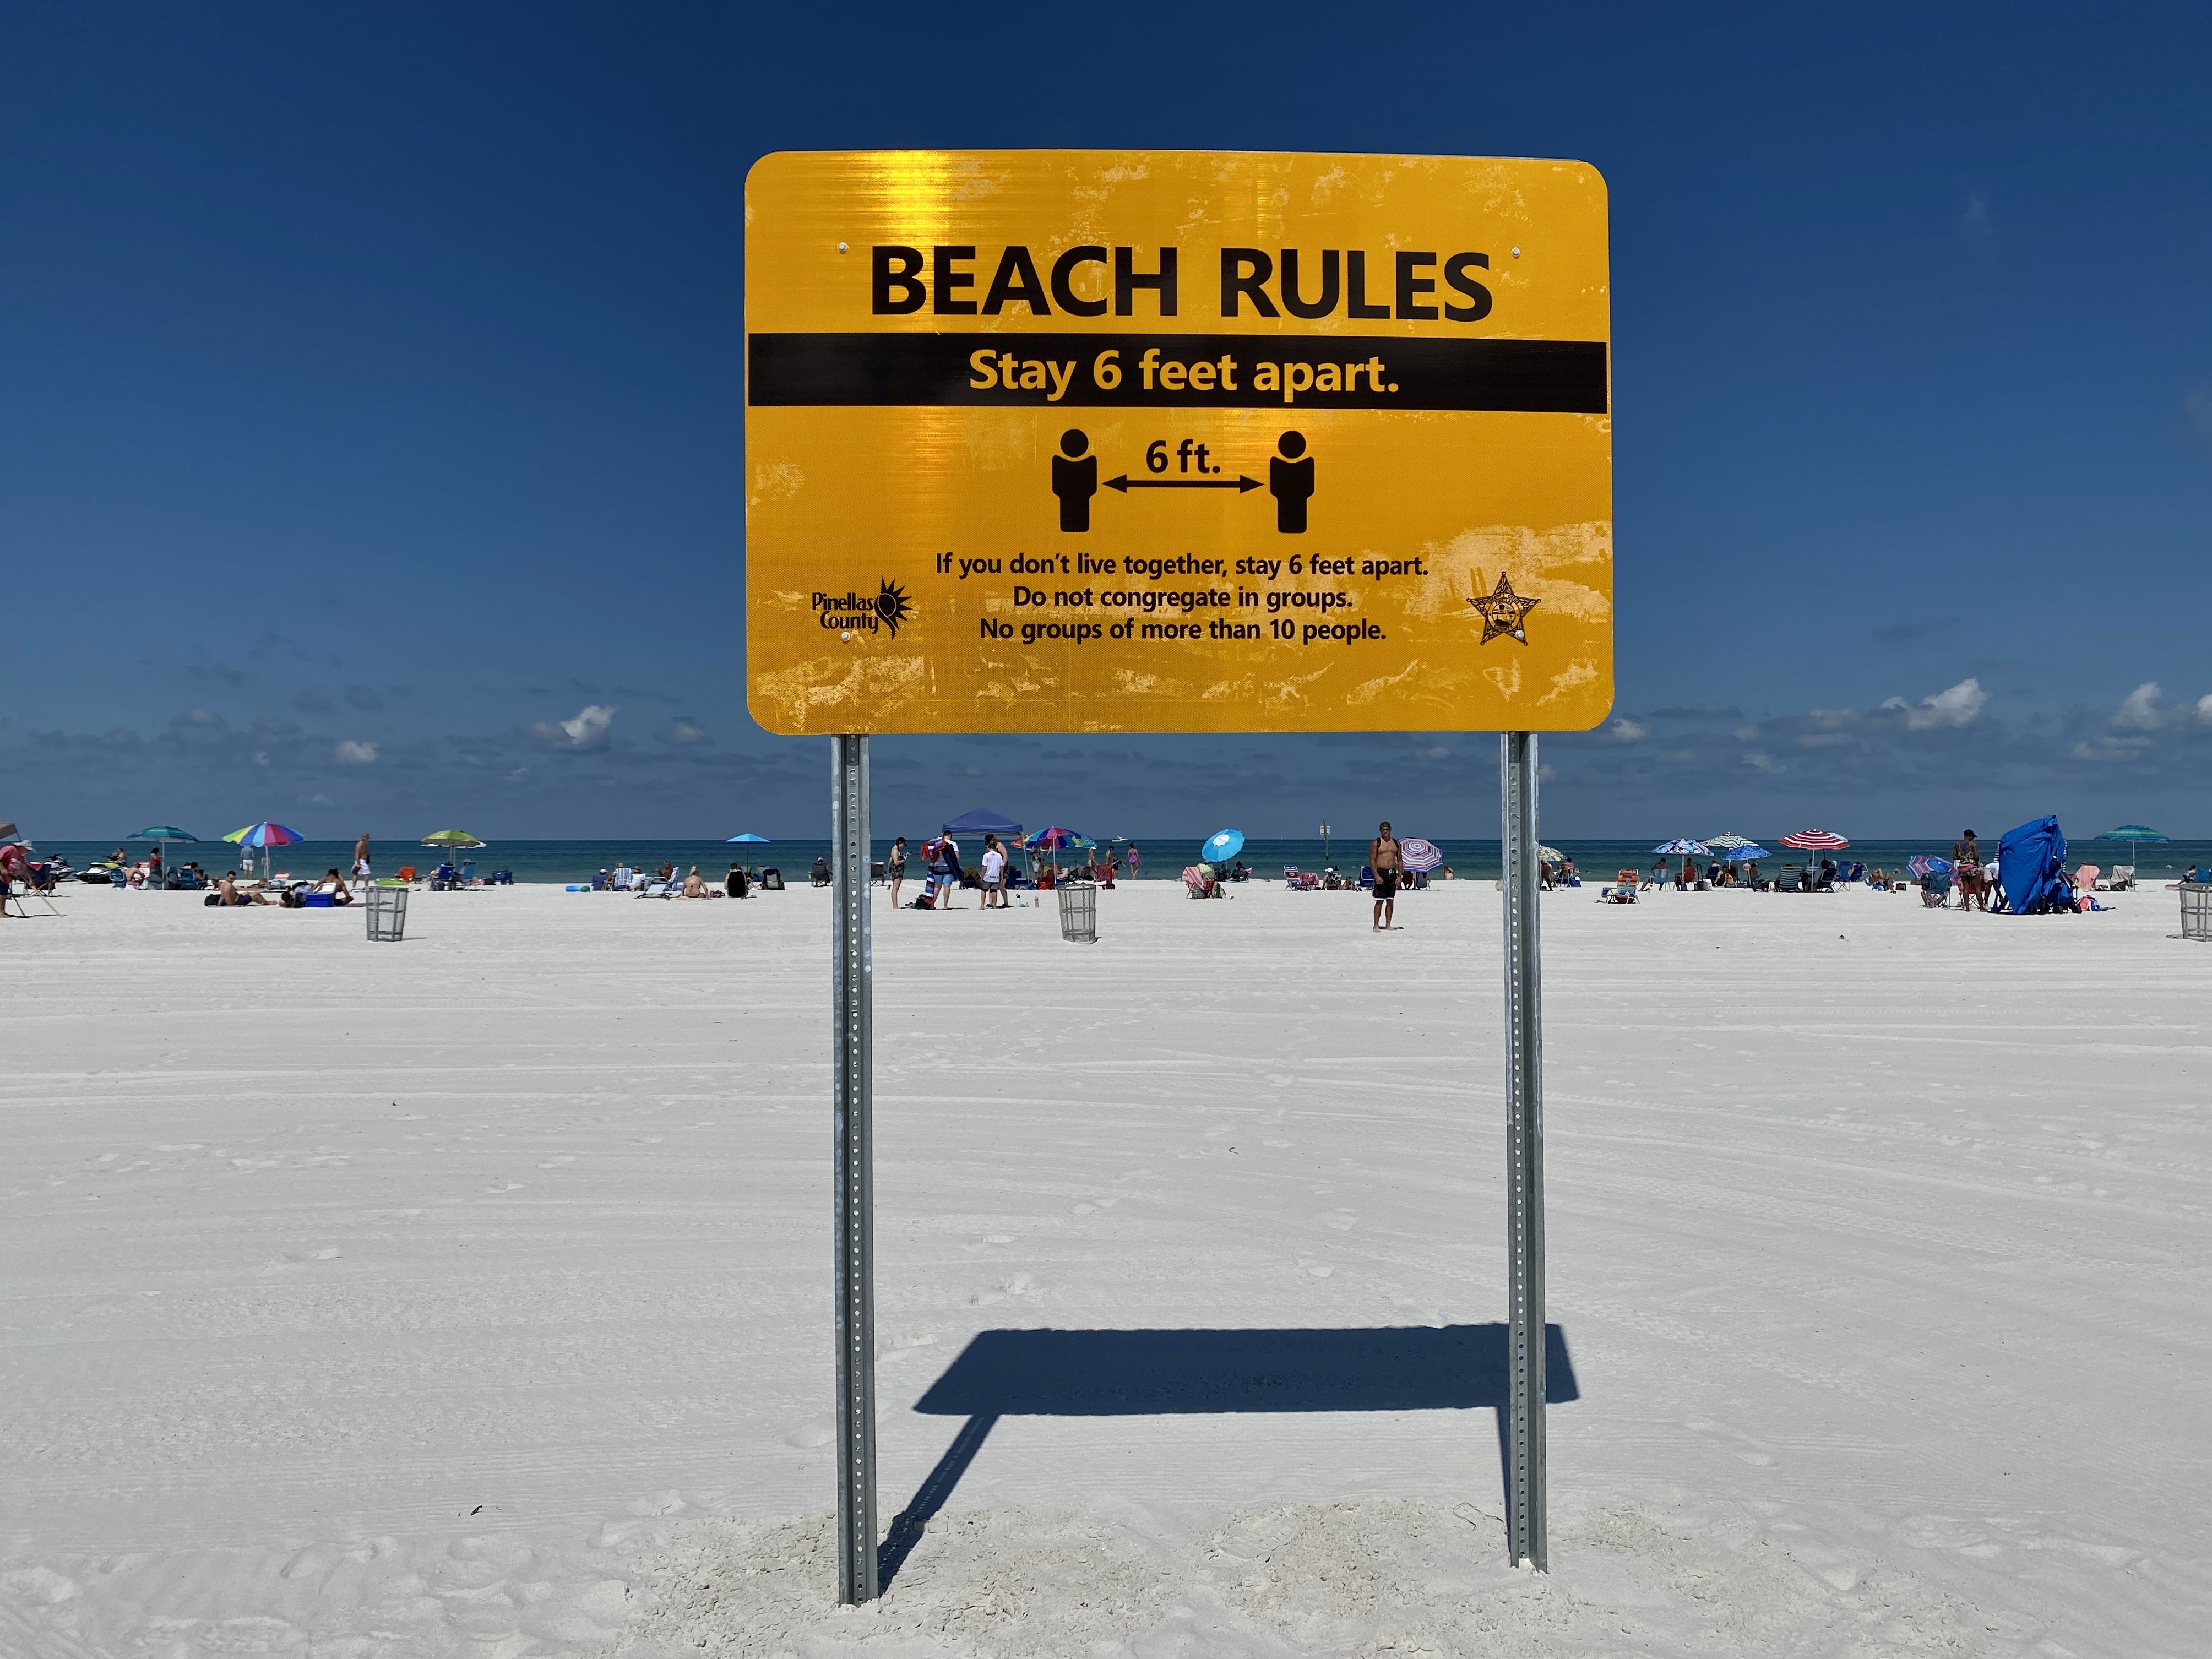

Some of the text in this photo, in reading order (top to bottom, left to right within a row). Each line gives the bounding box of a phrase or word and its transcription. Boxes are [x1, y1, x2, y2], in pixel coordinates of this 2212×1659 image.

[872, 245, 1492, 322] BEACH RULES
[970, 348, 1399, 404] Stay 6 feet apart.
[1146, 438, 1220, 474] 6 ft.
[937, 552, 1428, 581] If you don't live together, stay 6 feet apart.
[812, 592, 874, 611] Pinellas
[1014, 585, 1353, 613] Do not congregate in groups.
[820, 611, 879, 635] County
[980, 617, 1387, 646] No groups of more than 10 people.
